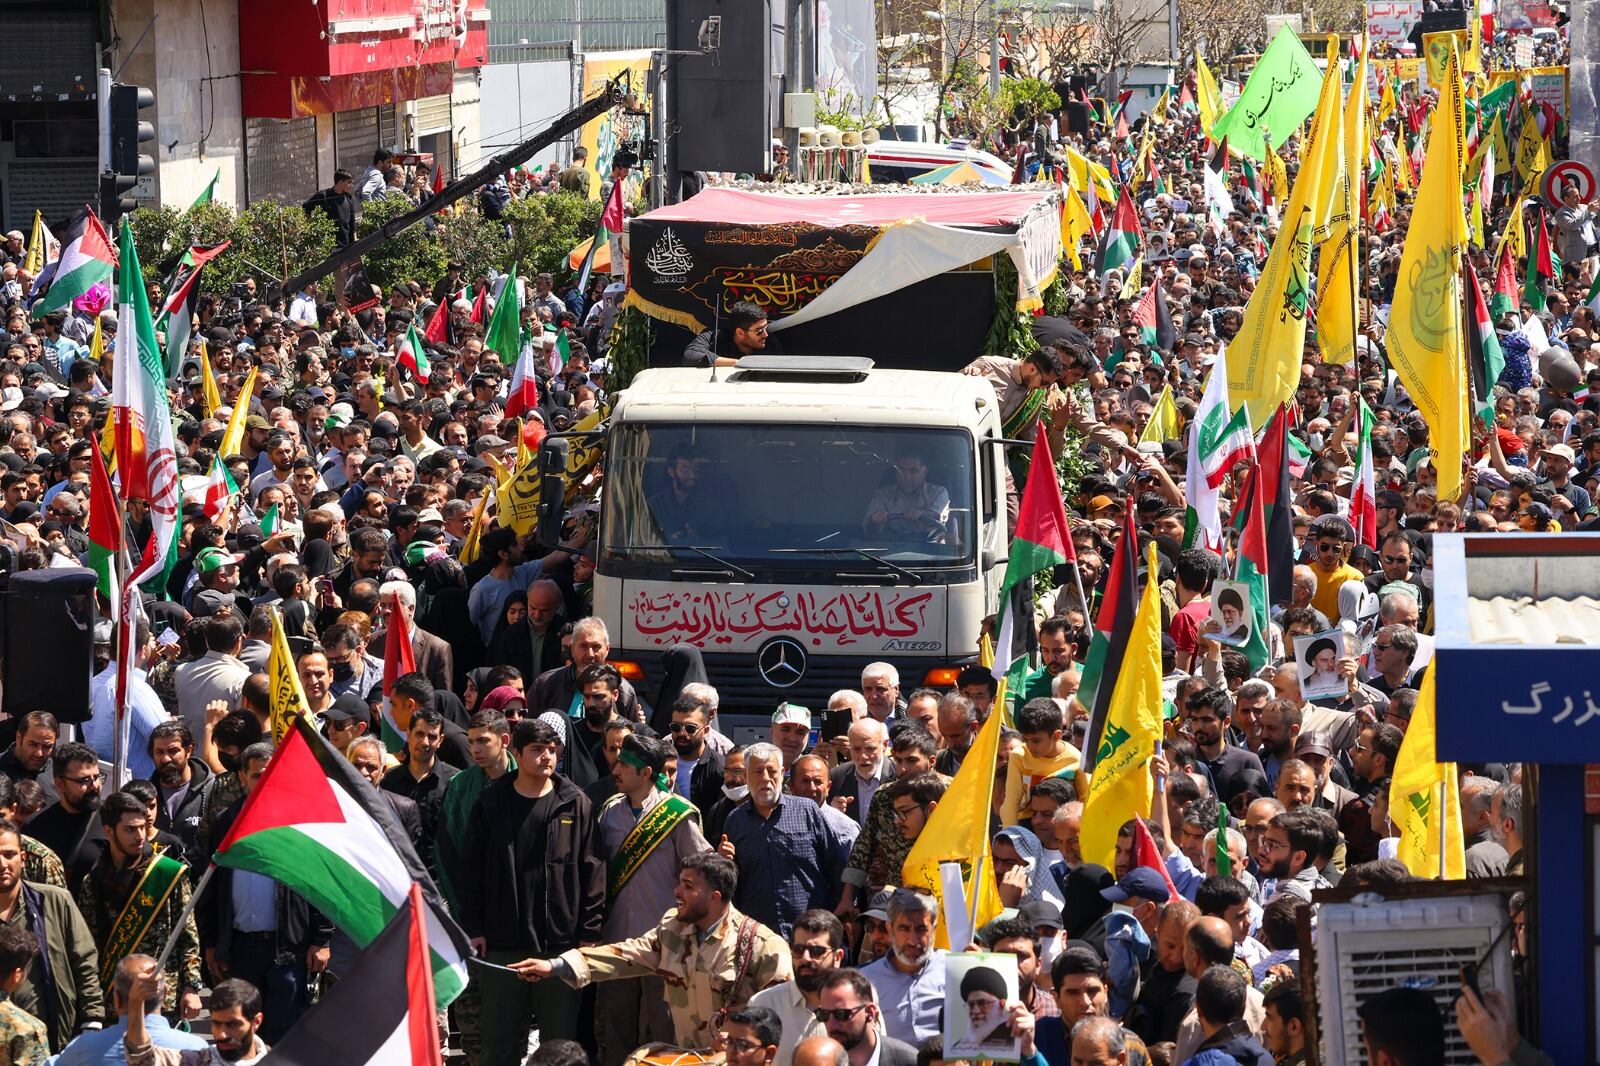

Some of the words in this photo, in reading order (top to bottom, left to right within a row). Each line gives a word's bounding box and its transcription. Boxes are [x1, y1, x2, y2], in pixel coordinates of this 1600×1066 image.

[1368, 3, 1413, 20] اسرائیل
[1289, 51, 1303, 86] لبیک
[882, 638, 942, 651] ATEGO
[1502, 680, 1600, 727] زرگ
